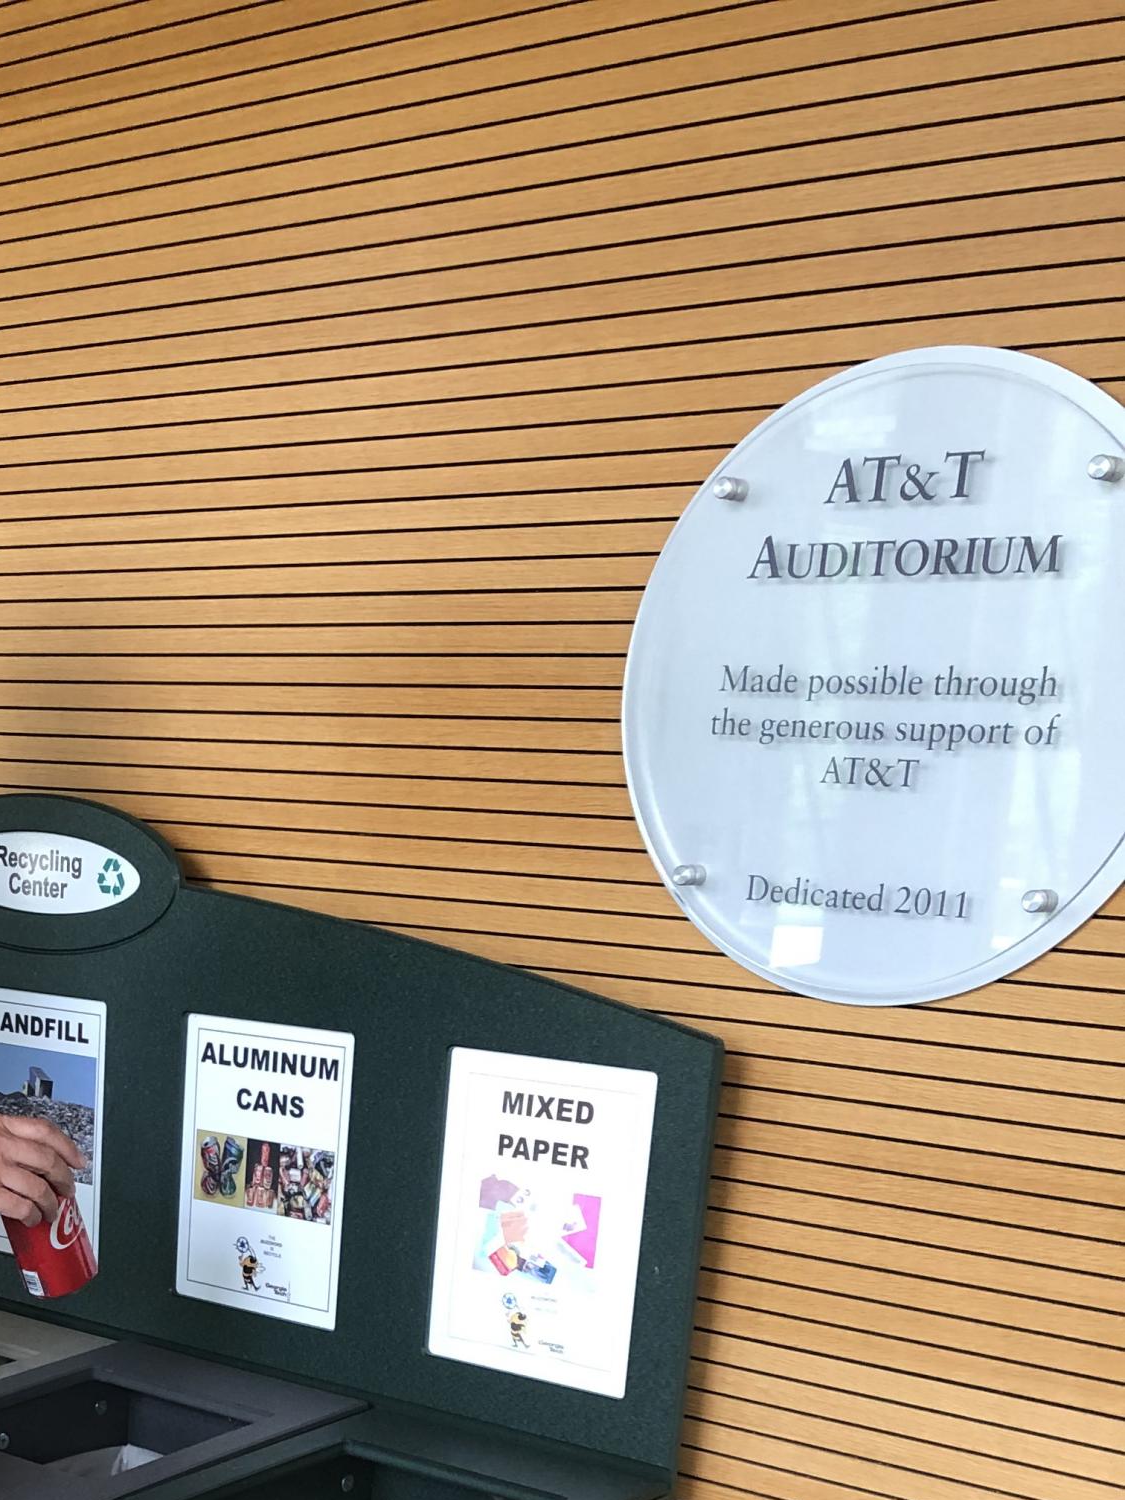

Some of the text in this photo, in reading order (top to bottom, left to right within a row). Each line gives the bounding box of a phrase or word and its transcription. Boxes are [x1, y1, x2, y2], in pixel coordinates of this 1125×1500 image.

[823, 450, 986, 504] AT&T
[747, 534, 1064, 579] AUDITORIUM
[719, 664, 1058, 706] Made possible through
[711, 707, 1062, 751] the generous support of
[819, 756, 920, 788] AT&T
[8, 873, 68, 899] Center
[746, 874, 969, 919] Dedicated 2011
[200, 1041, 340, 1082] ALUMINUM
[236, 1087, 305, 1119] CANS
[501, 1090, 595, 1125] MIXED
[497, 1133, 590, 1170] PAPER
